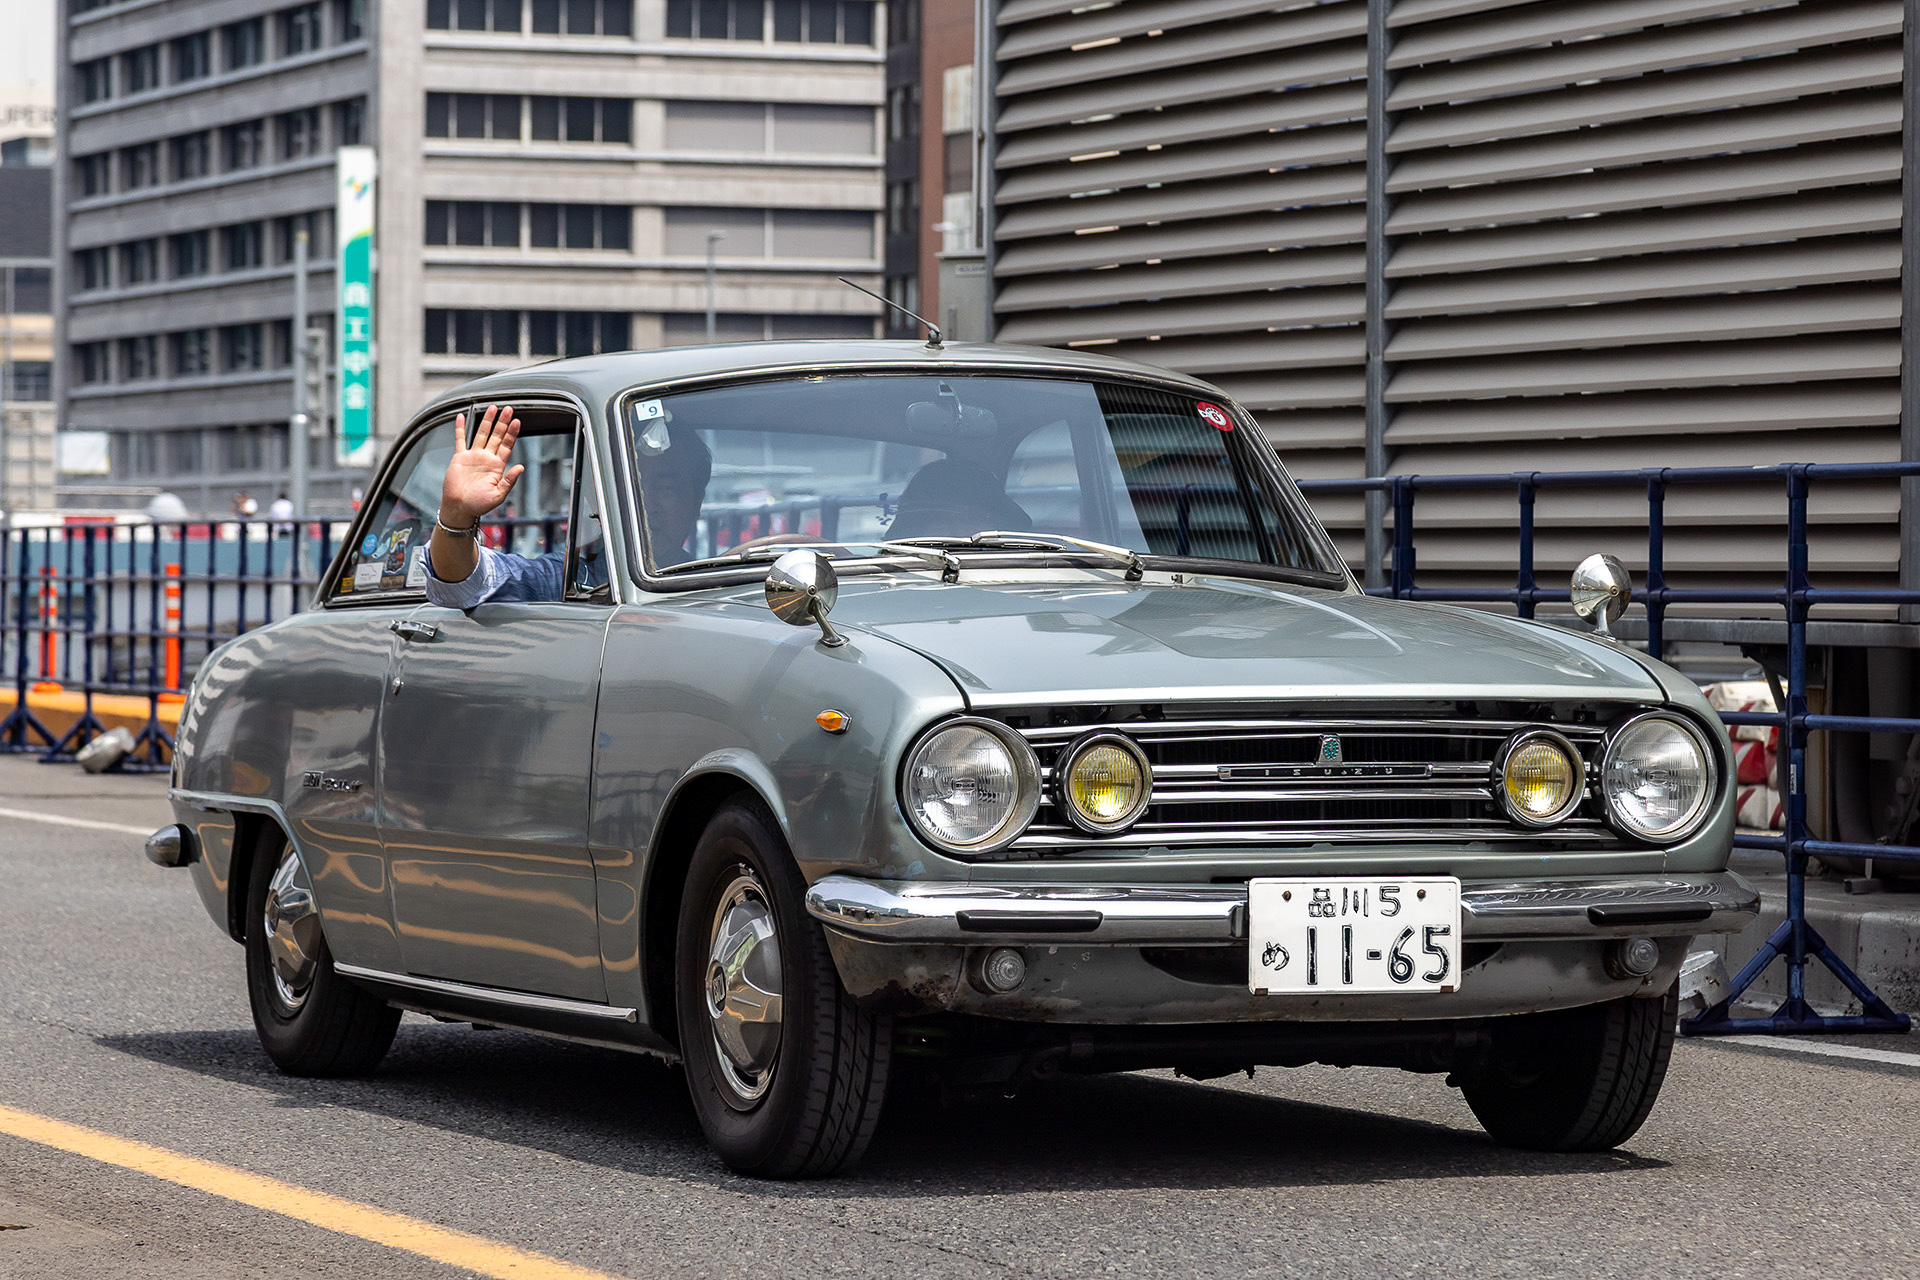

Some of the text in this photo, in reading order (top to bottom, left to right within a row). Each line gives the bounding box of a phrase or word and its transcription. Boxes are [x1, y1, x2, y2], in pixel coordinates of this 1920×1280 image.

[648, 405, 658, 417] 9
[1265, 766, 1393, 776] ISUZU
[1262, 924, 1451, 985] め 11-65
